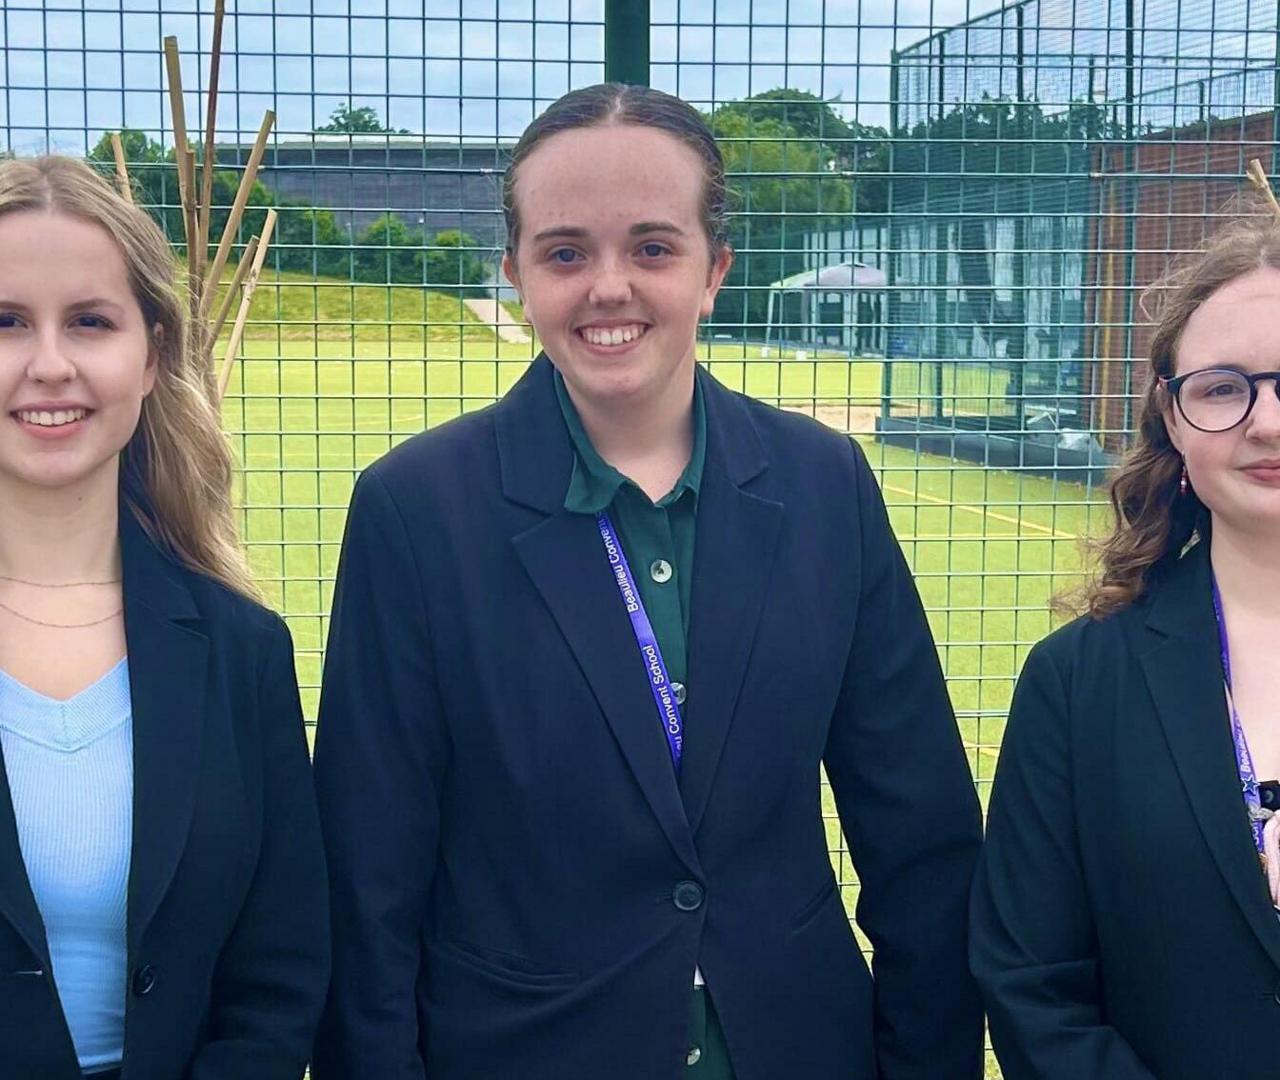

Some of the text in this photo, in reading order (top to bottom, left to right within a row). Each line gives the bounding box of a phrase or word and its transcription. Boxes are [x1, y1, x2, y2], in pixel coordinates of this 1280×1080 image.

[613, 564, 639, 613] Beaulieu
[643, 644, 680, 734] Convent School
